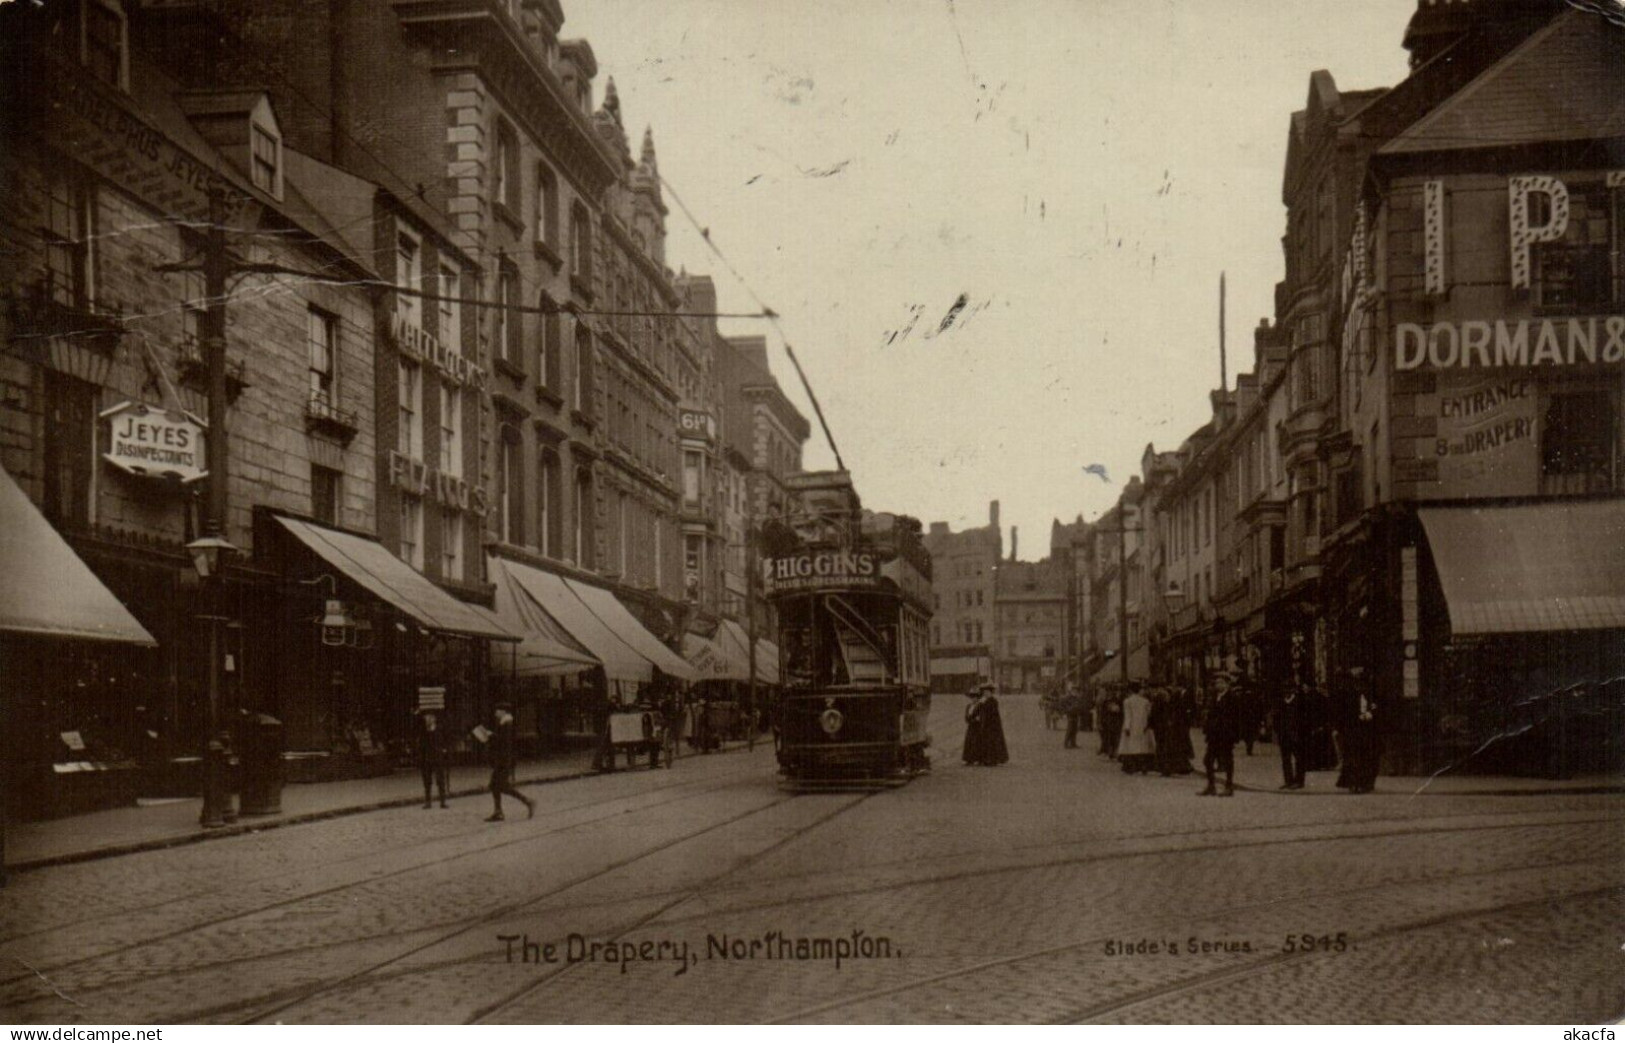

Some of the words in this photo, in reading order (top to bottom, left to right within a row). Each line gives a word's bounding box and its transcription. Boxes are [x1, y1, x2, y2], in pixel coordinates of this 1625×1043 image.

[1395, 317, 1597, 370] DORMAN
[1440, 378, 1530, 418] ENTRANCE
[118, 417, 189, 448] JEYES
[1465, 416, 1535, 454] DRAPERY
[116, 440, 194, 468] DISINFECTANTS
